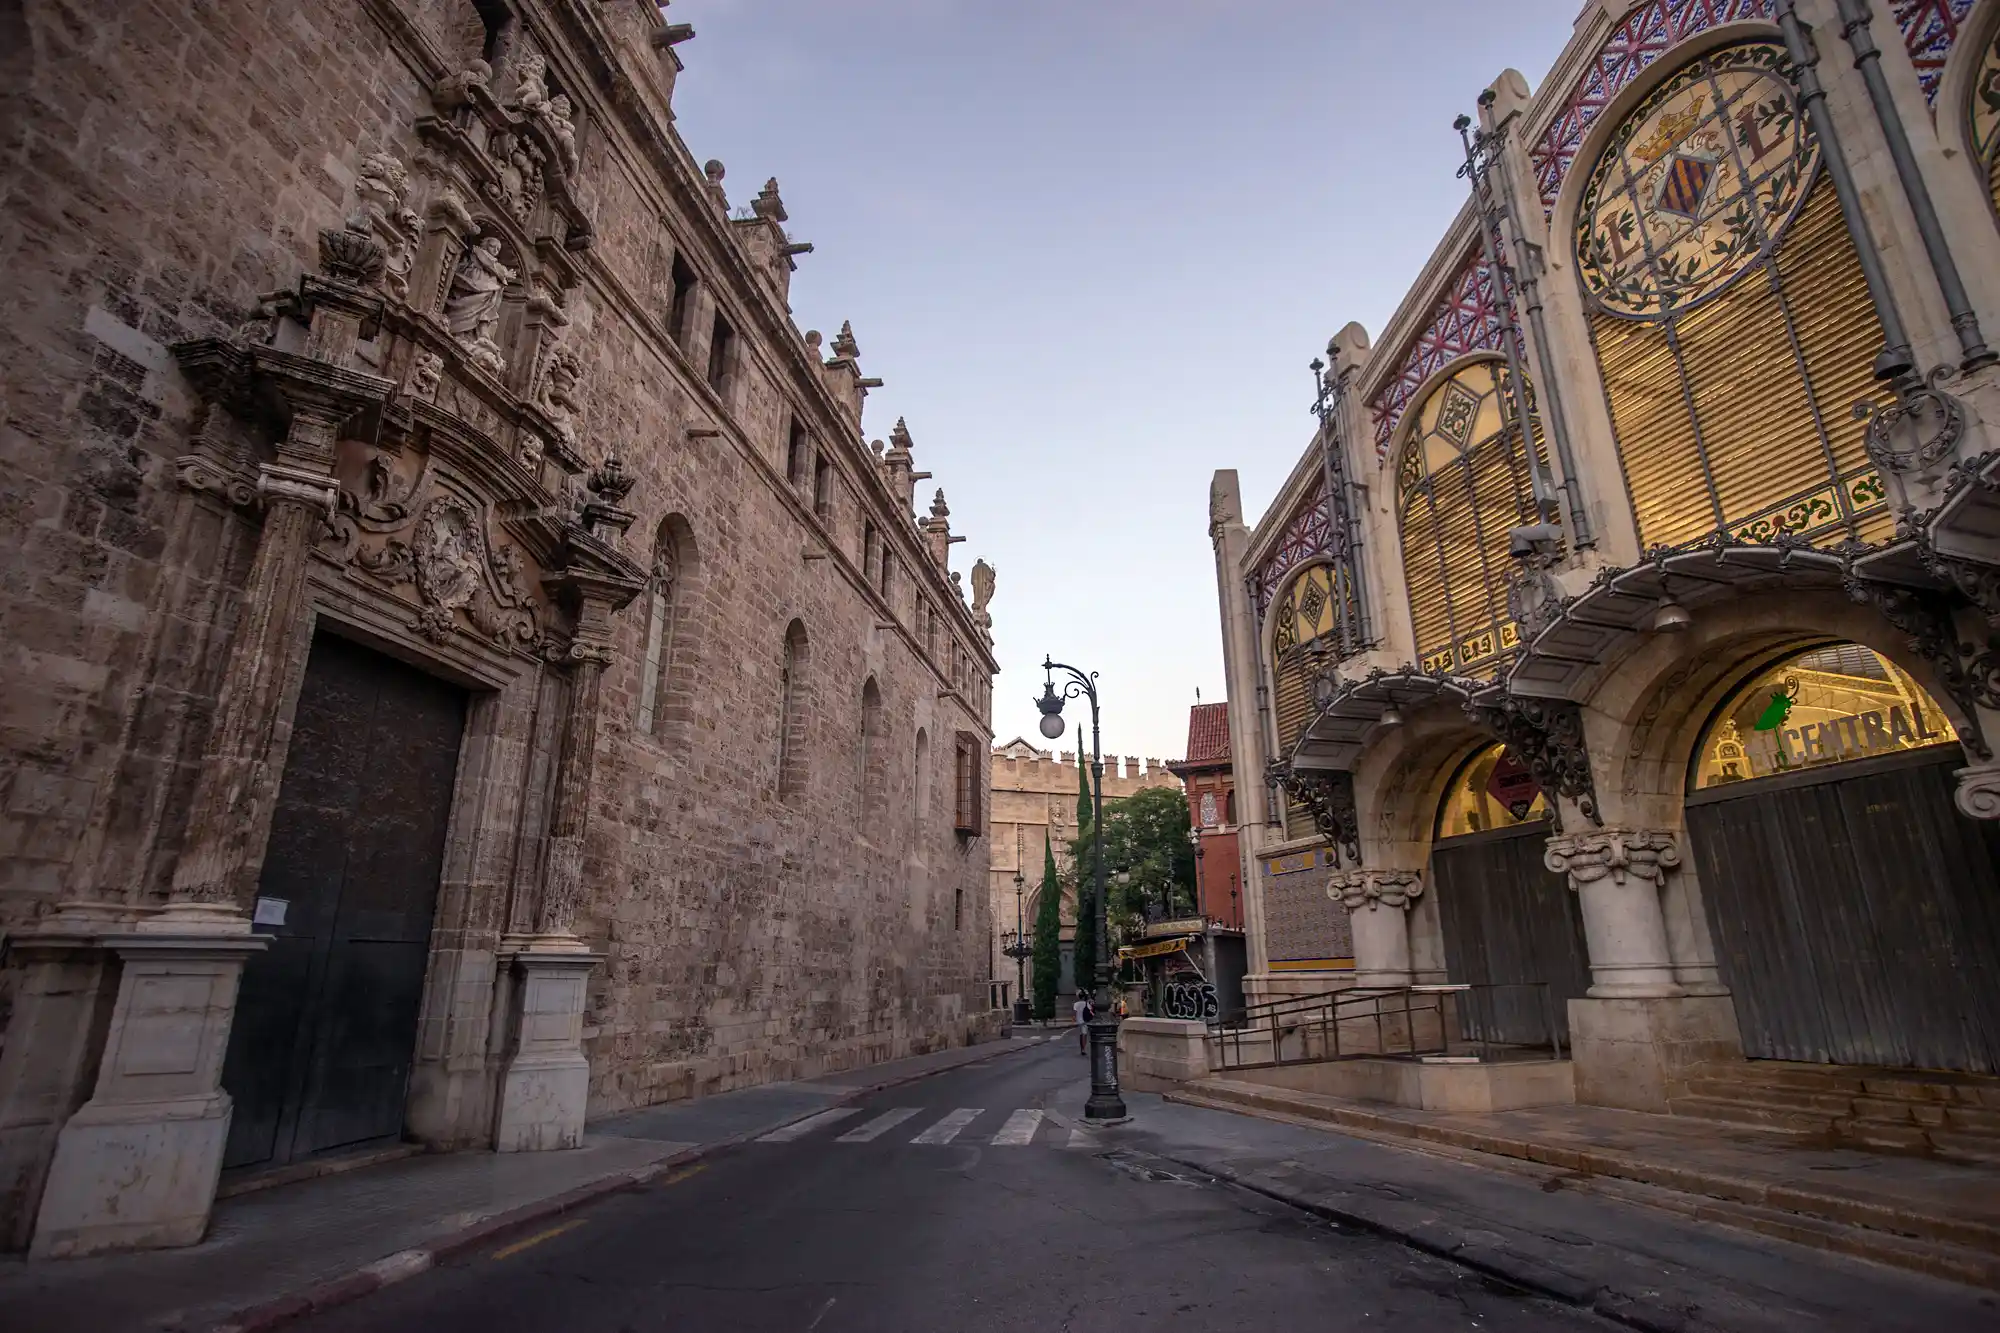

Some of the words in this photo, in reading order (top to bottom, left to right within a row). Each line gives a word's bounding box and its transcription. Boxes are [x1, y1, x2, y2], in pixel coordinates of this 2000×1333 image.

[1602, 211, 1641, 266] L
[1735, 103, 1786, 164] L
[1783, 703, 1938, 763] CENTRAL
